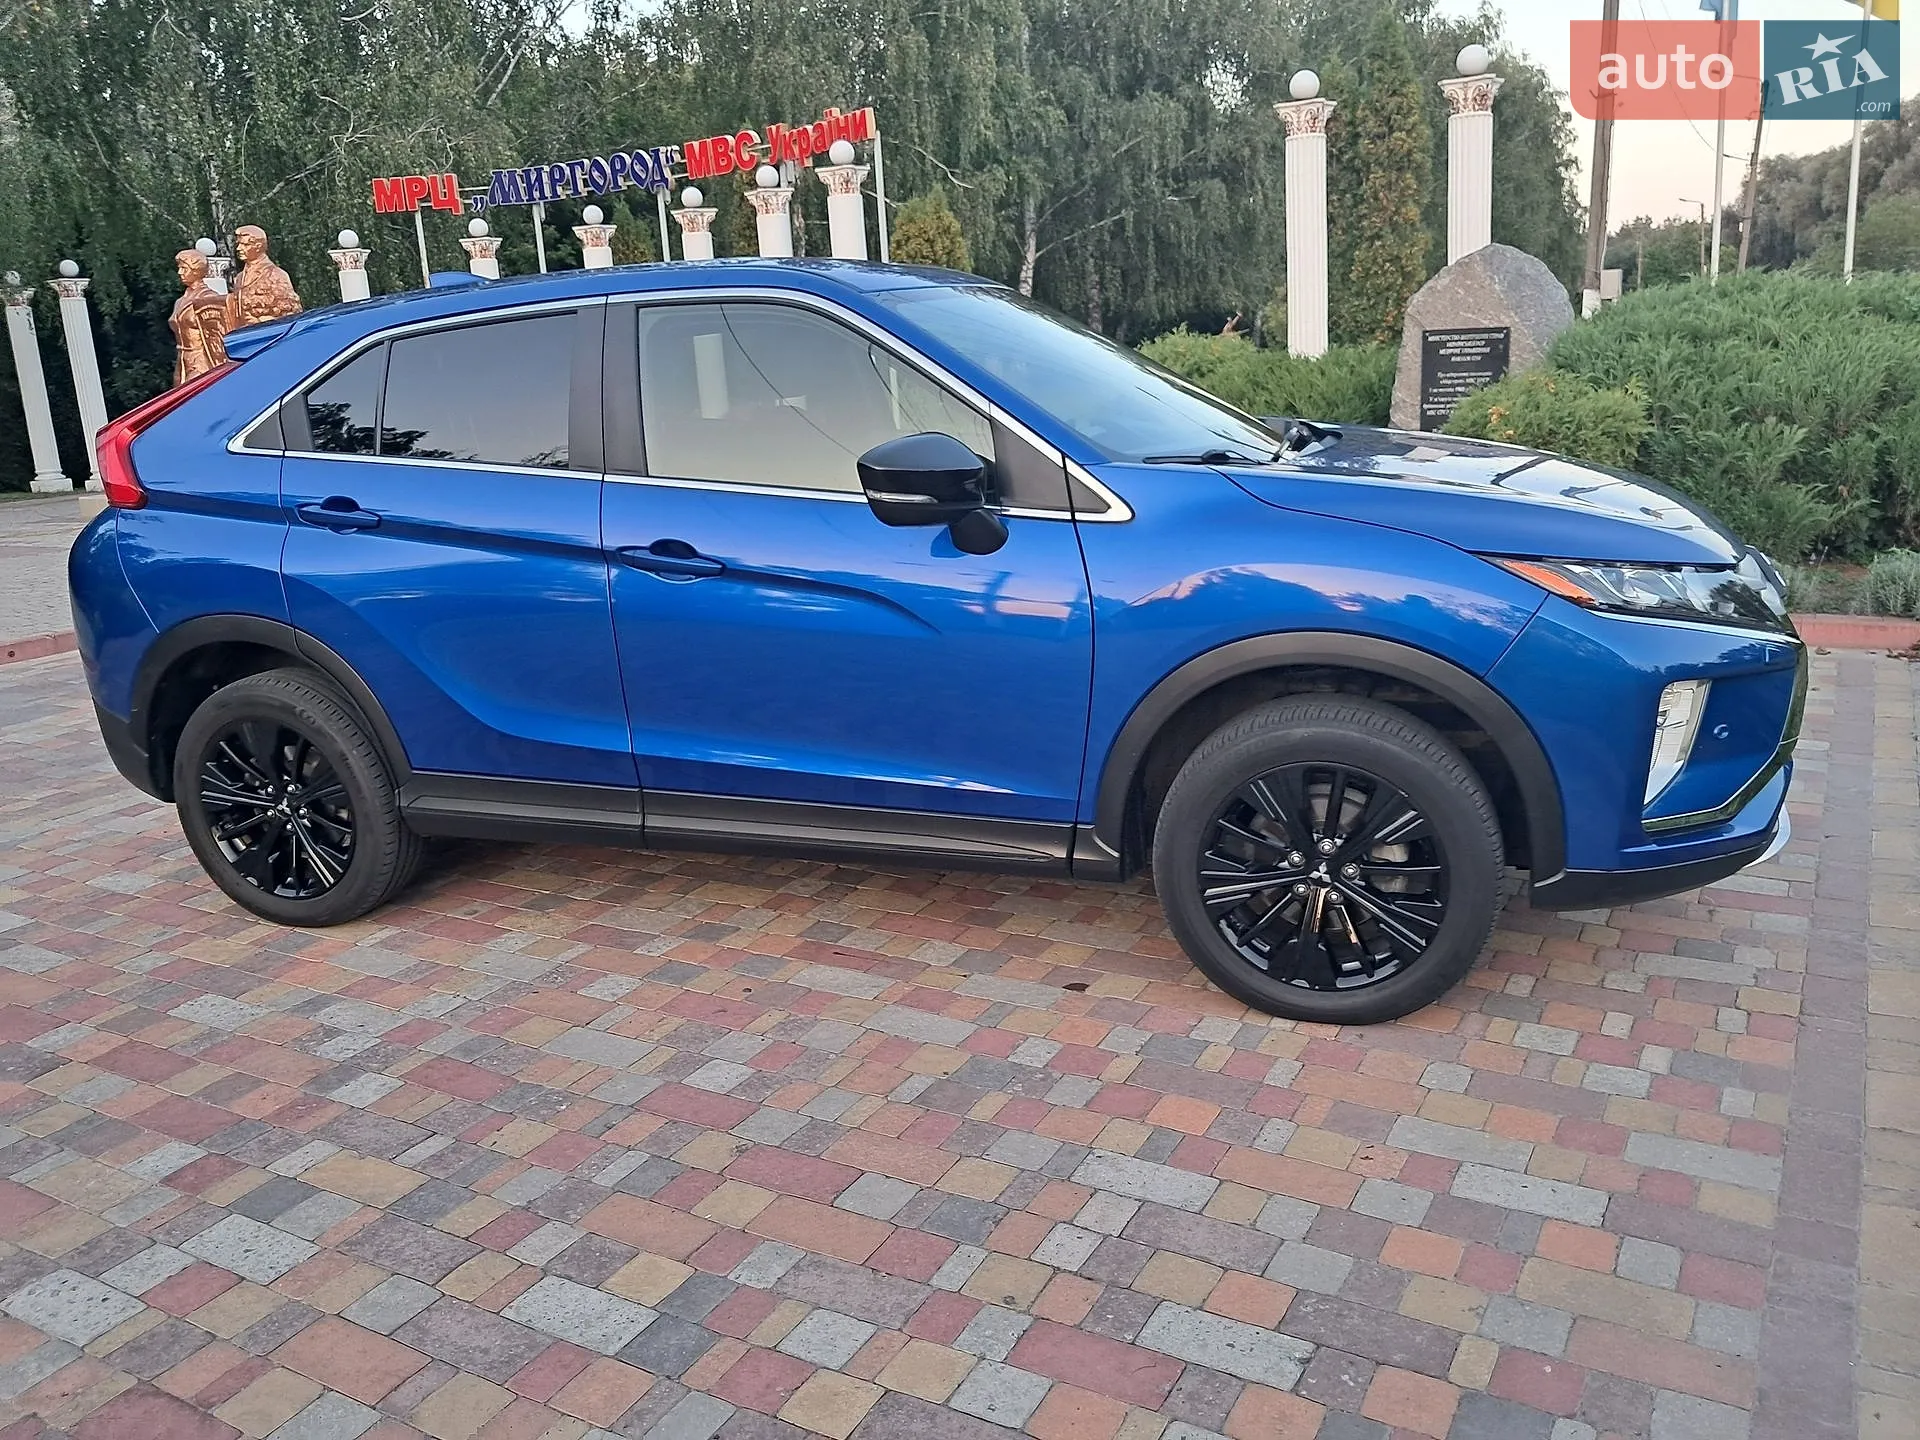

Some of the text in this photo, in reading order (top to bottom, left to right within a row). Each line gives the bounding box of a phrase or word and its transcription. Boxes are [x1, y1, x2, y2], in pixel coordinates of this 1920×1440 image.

[372, 173, 463, 215] МРЦ
[684, 130, 761, 180] МВС
[766, 107, 876, 168] України
